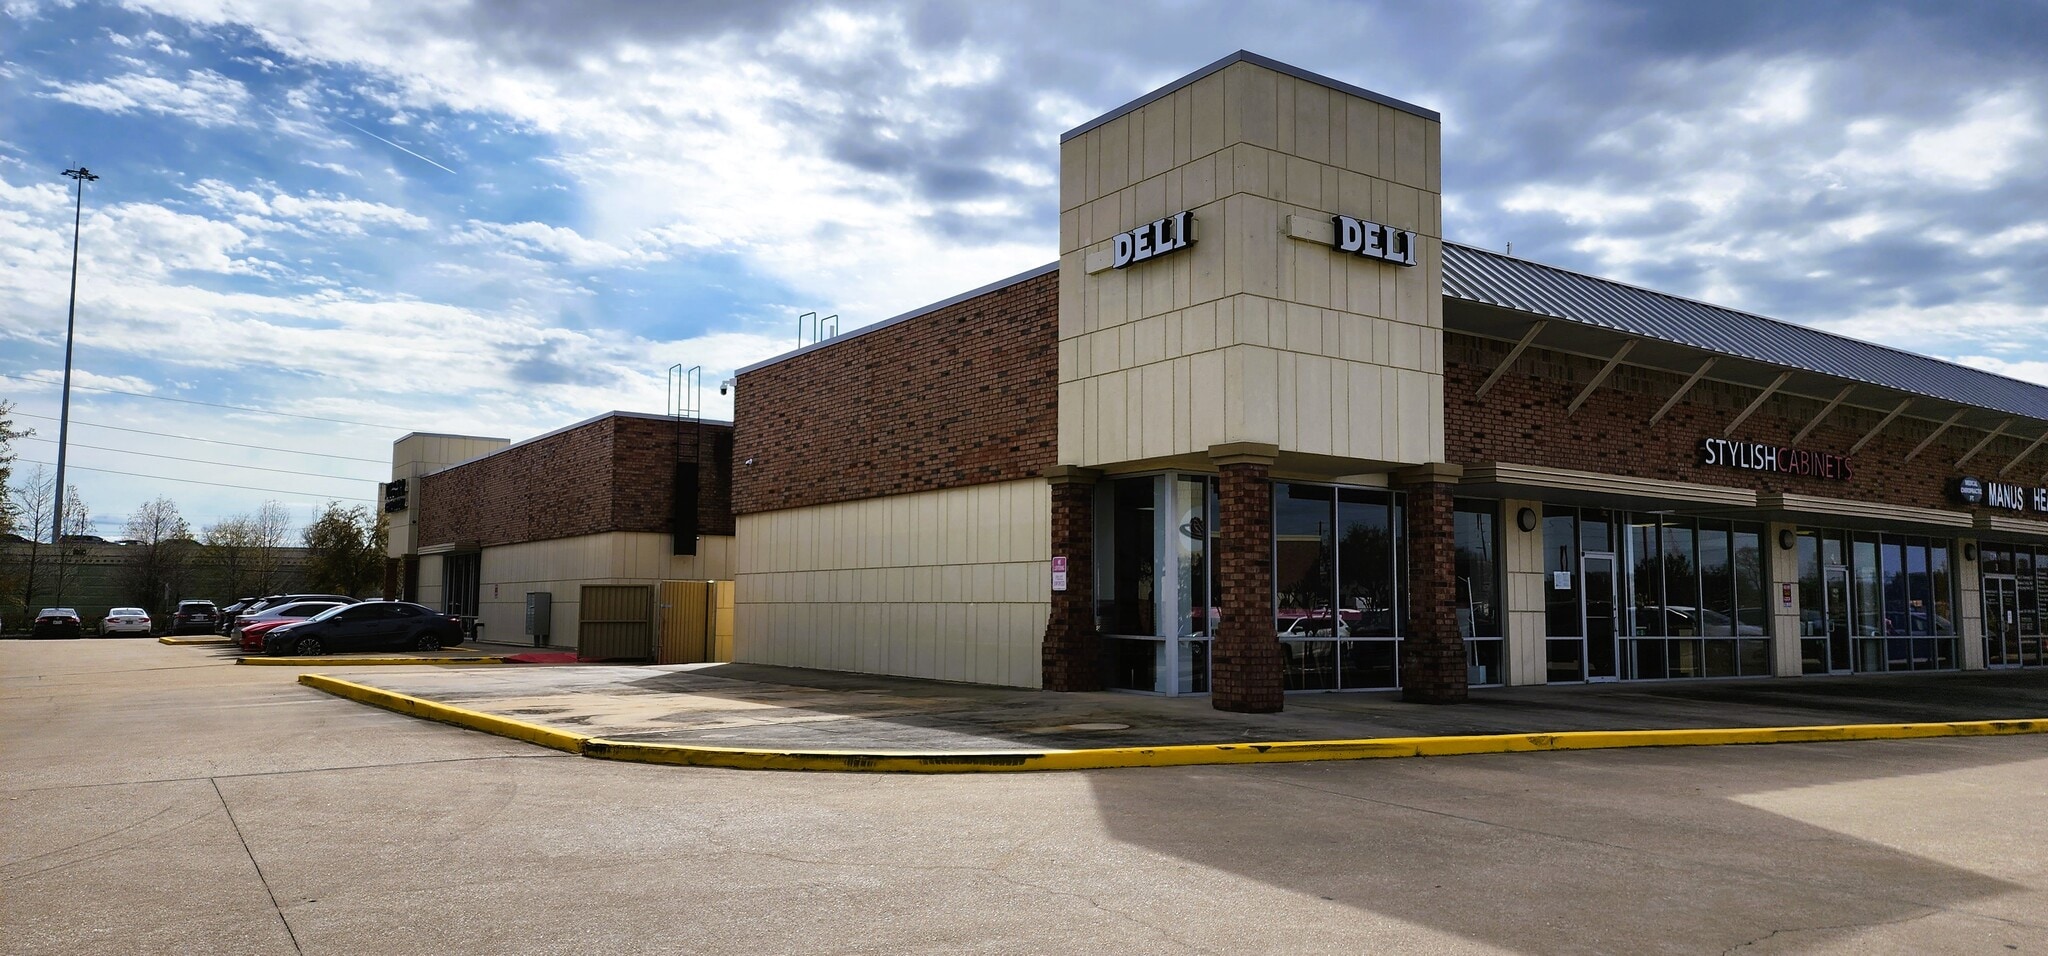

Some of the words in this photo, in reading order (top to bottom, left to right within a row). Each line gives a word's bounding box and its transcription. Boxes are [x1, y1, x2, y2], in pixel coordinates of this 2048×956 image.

[1112, 211, 1191, 269] DELI
[1336, 215, 1417, 266] DELI
[1988, 482, 2024, 511] MANUS
[2033, 487, 2048, 512] HE
